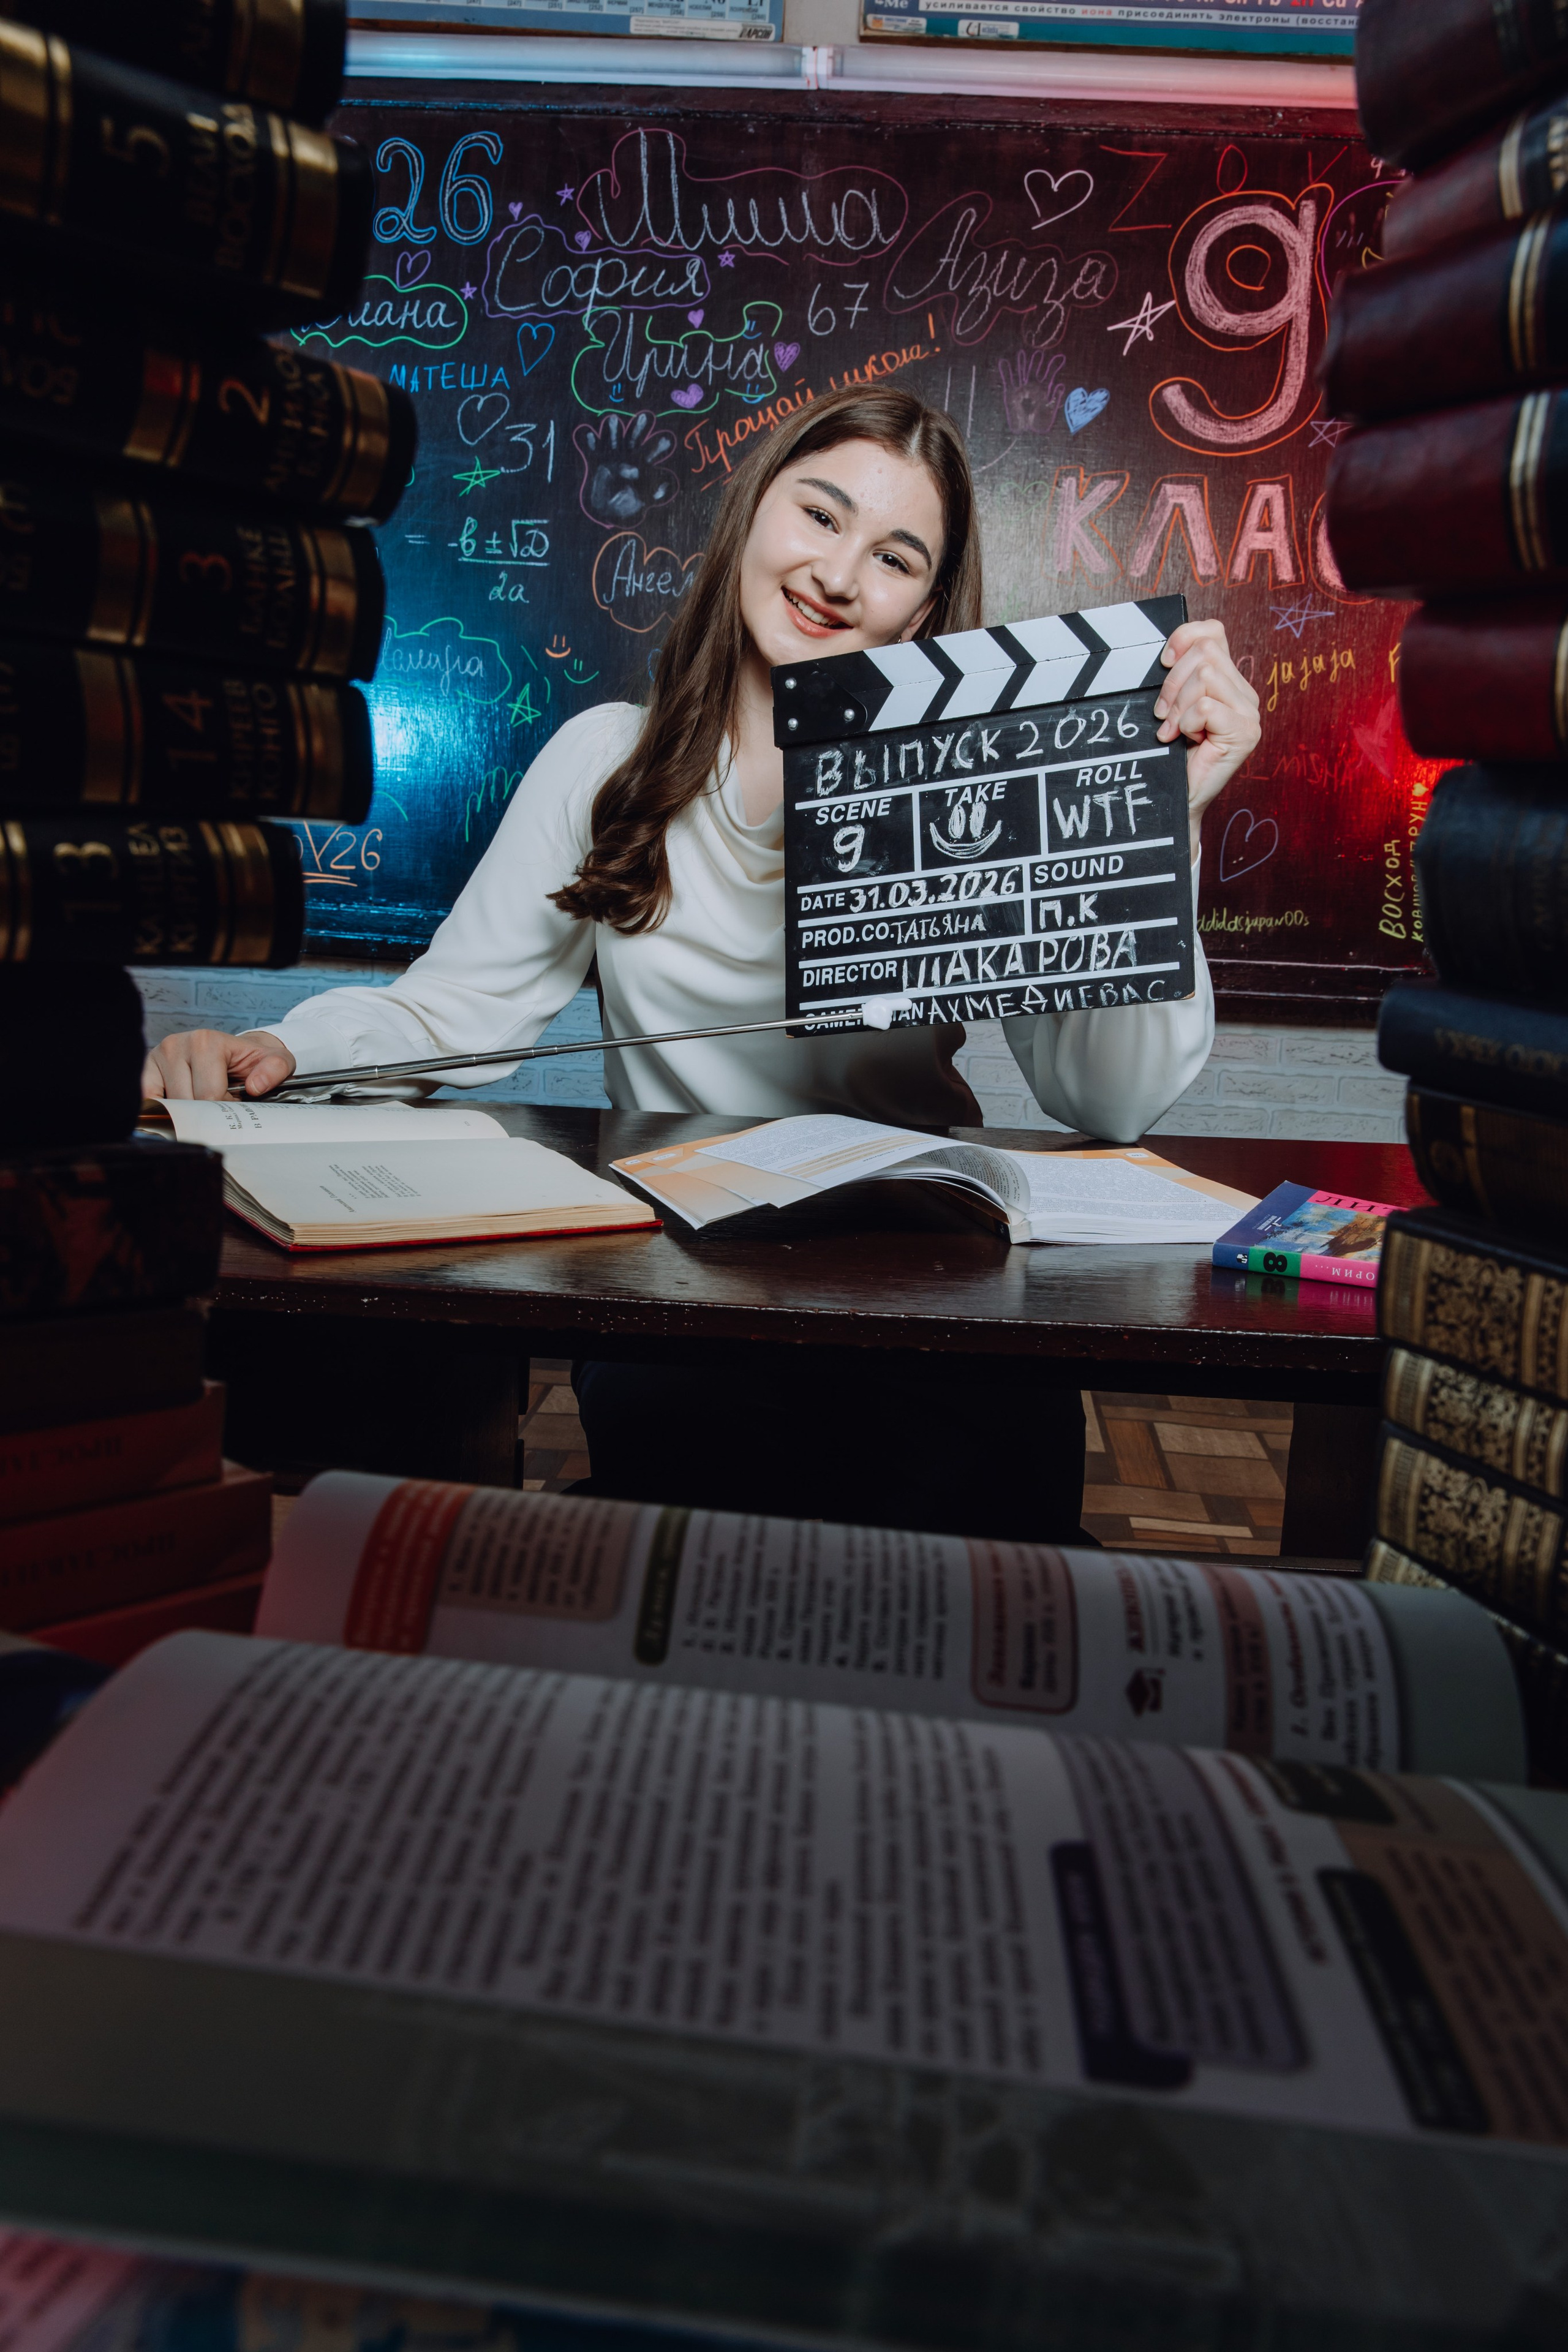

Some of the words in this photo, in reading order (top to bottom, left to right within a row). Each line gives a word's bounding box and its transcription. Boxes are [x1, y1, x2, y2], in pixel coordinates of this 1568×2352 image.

[925, 1, 1009, 12] усиливается
[1014, 4, 1076, 15] свойство
[1118, 9, 1213, 20] присоединять
[1219, 13, 1291, 24] электроны
[373, 130, 503, 244] 26
[494, 225, 704, 330] София
[807, 282, 869, 336] 67
[586, 311, 769, 398] Ирина
[500, 419, 554, 484] 31
[178, 550, 234, 595] 3
[161, 686, 219, 772] 14
[816, 728, 1002, 797] ВЫПУСК
[1015, 699, 1142, 760] 2026
[944, 780, 1008, 807] TAKE
[1076, 761, 1144, 788] ROLL
[815, 797, 892, 826] SCENE
[1052, 782, 1155, 839] WTF
[832, 823, 866, 873] 9
[1034, 854, 1124, 884] SOUND
[53, 840, 123, 924] 13
[801, 891, 846, 911] DATE
[849, 865, 1025, 914] 31.03.2026
[1378, 839, 1408, 940] ВОСХОД
[802, 923, 895, 949] PROD.CO.
[803, 960, 897, 987] DIRECTOR
[902, 927, 1138, 992] ШАКАРОВА
[1262, 1251, 1288, 1273] 8
